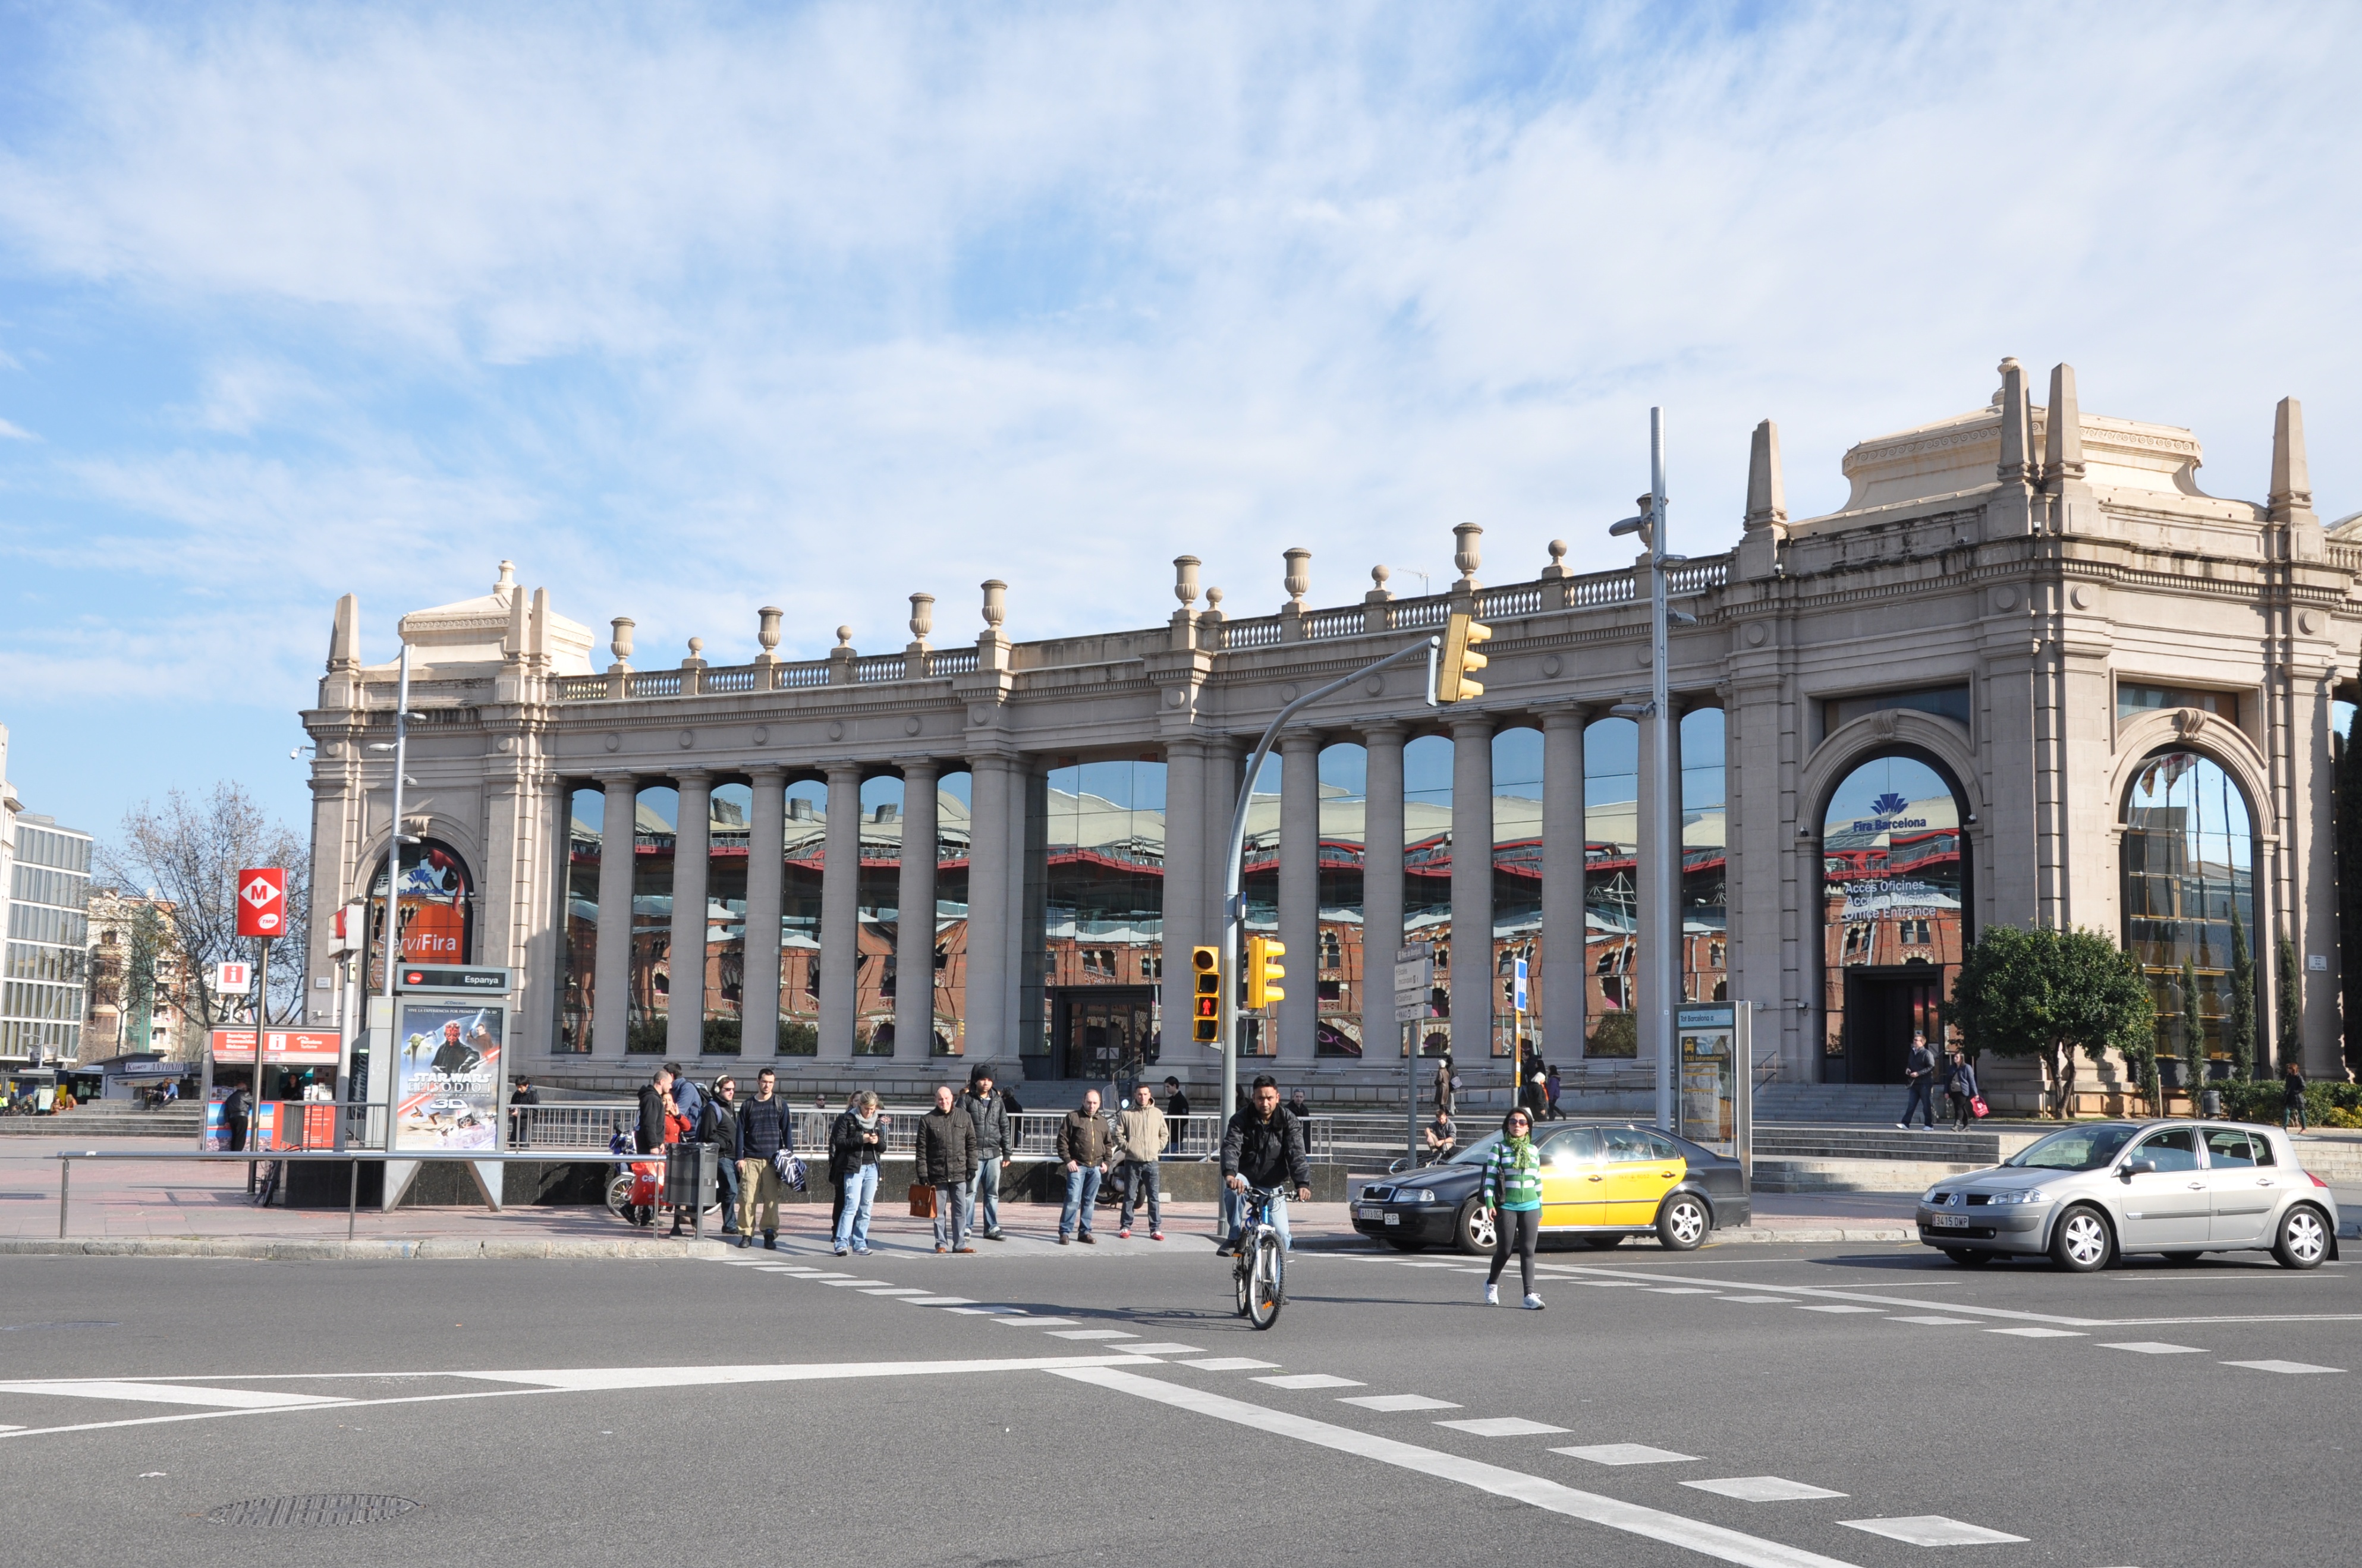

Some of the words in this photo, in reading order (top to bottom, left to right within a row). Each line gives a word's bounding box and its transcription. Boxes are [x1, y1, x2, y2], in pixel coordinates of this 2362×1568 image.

[1853, 821, 1873, 832] Fira
[1874, 817, 1926, 830] Barcelona
[1880, 880, 1925, 892] Oficines
[250, 885, 268, 900] M
[1845, 895, 1887, 906] Acceso
[1891, 892, 1939, 905] Oficinas
[1845, 908, 1879, 920] Office
[1883, 906, 1936, 918] Entrance
[378, 934, 456, 952] ServiFira
[464, 975, 499, 985] Espanya
[150, 1062, 183, 1071] ANTONIO
[408, 1072, 450, 1082] STAR
[451, 1072, 493, 1083] WARS
[407, 1082, 482, 1092] EPISODIO
[488, 1083, 491, 1092] I
[429, 1098, 468, 1110] 3D
[1386, 1215, 1397, 1223] SP
[1936, 1216, 1953, 1226] 3415
[1954, 1217, 1967, 1226] DMP
